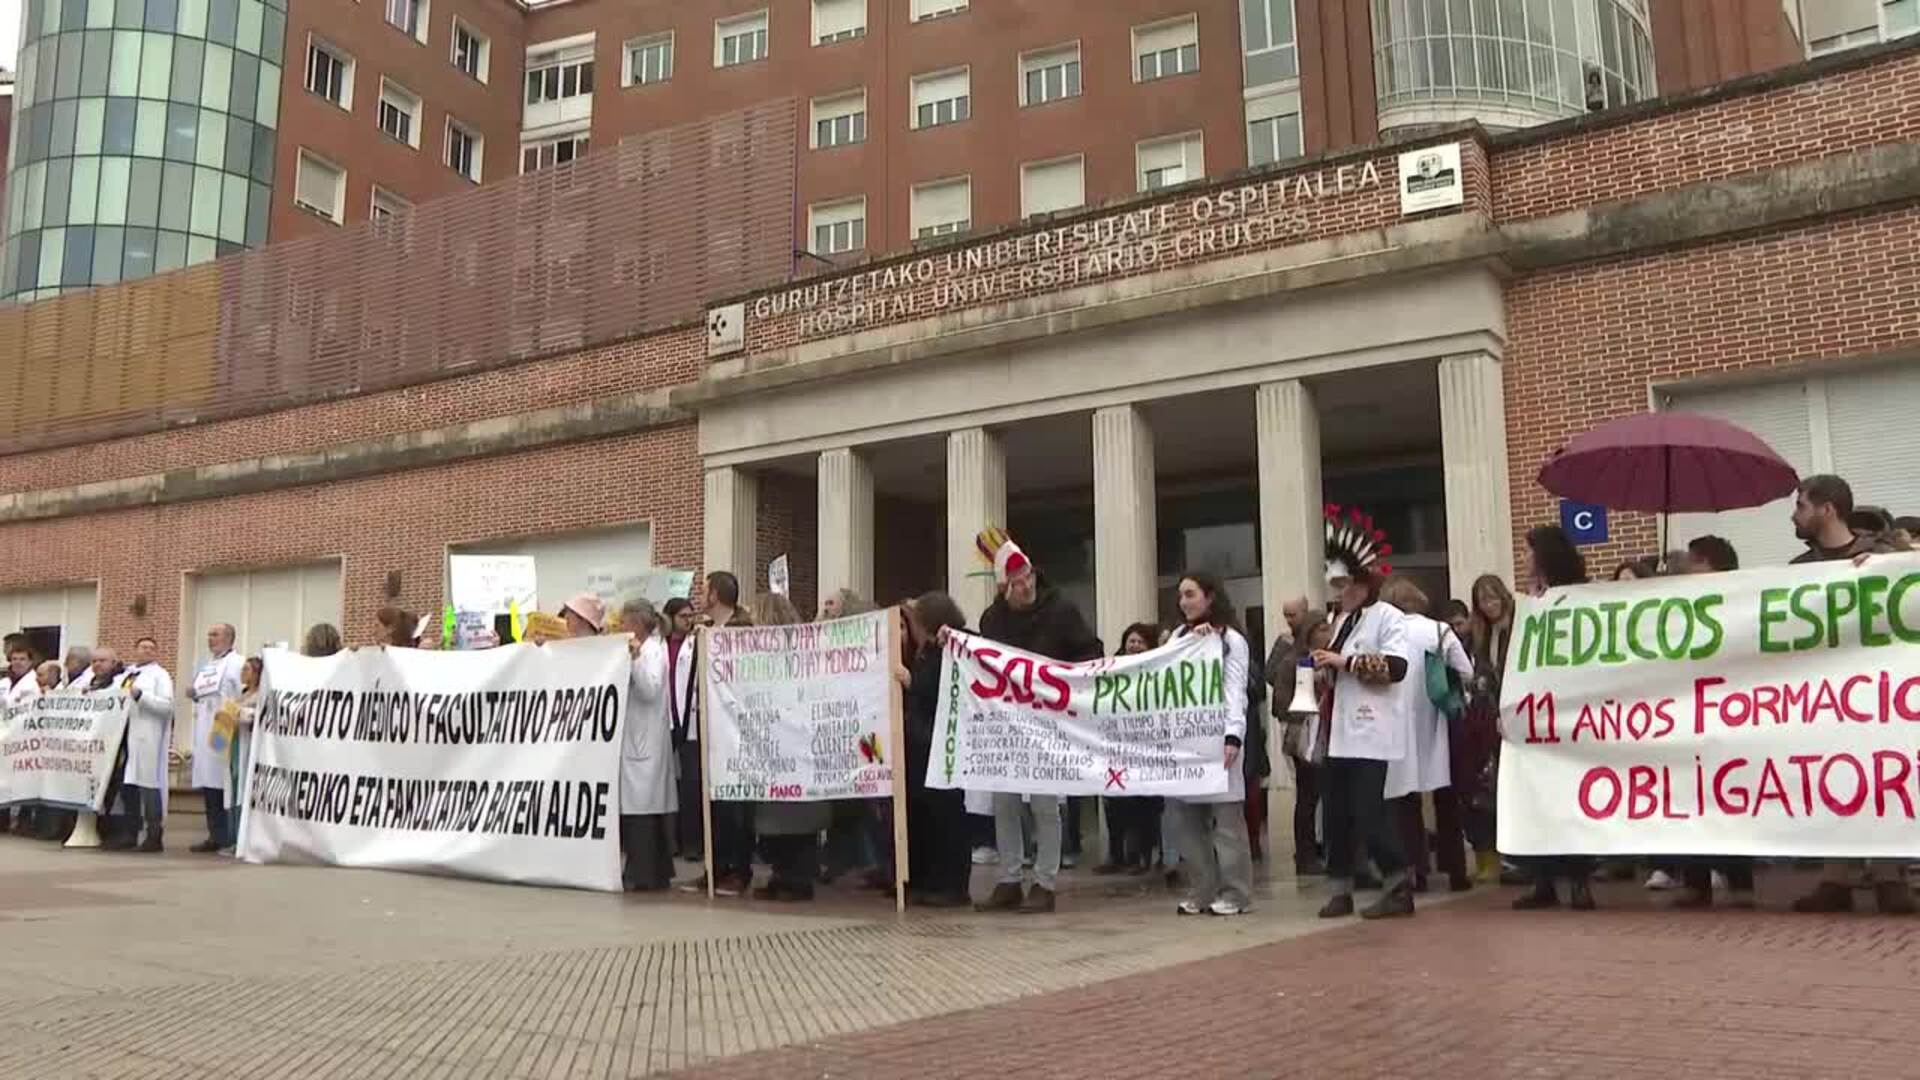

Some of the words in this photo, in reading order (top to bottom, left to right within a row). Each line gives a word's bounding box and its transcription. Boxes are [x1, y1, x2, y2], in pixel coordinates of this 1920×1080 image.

[755, 258, 933, 319] GURUTZETAKO
[946, 202, 1176, 275] UNIBERTSITATE
[1193, 160, 1381, 222] OSPITALEA
[800, 291, 922, 336] HOSPITAL
[934, 241, 1159, 308] UNIVERSITARIO
[1175, 209, 1311, 258] CRUCES
[1574, 511, 1593, 530] C
[1517, 594, 1725, 672] MÉDICOS
[1759, 572, 1920, 653] ESPEC
[712, 658, 733, 684] SIN
[1093, 658, 1224, 715] PRIMARIA
[354, 678, 410, 744] MÉDICO
[413, 692, 428, 744] Y
[426, 689, 548, 745] FACULTATIVO
[545, 684, 619, 742] PROPIO
[1516, 690, 1561, 744] 11
[1571, 698, 1676, 742] AÑOS
[970, 751, 1030, 765] CONTRATOS
[1014, 766, 1030, 779] SIN
[1032, 767, 1084, 780] CONTROL
[349, 776, 384, 828] ETA
[382, 777, 490, 833] FAKULTATIBO
[482, 780, 544, 836] BATEN
[544, 780, 609, 840] ALDE
